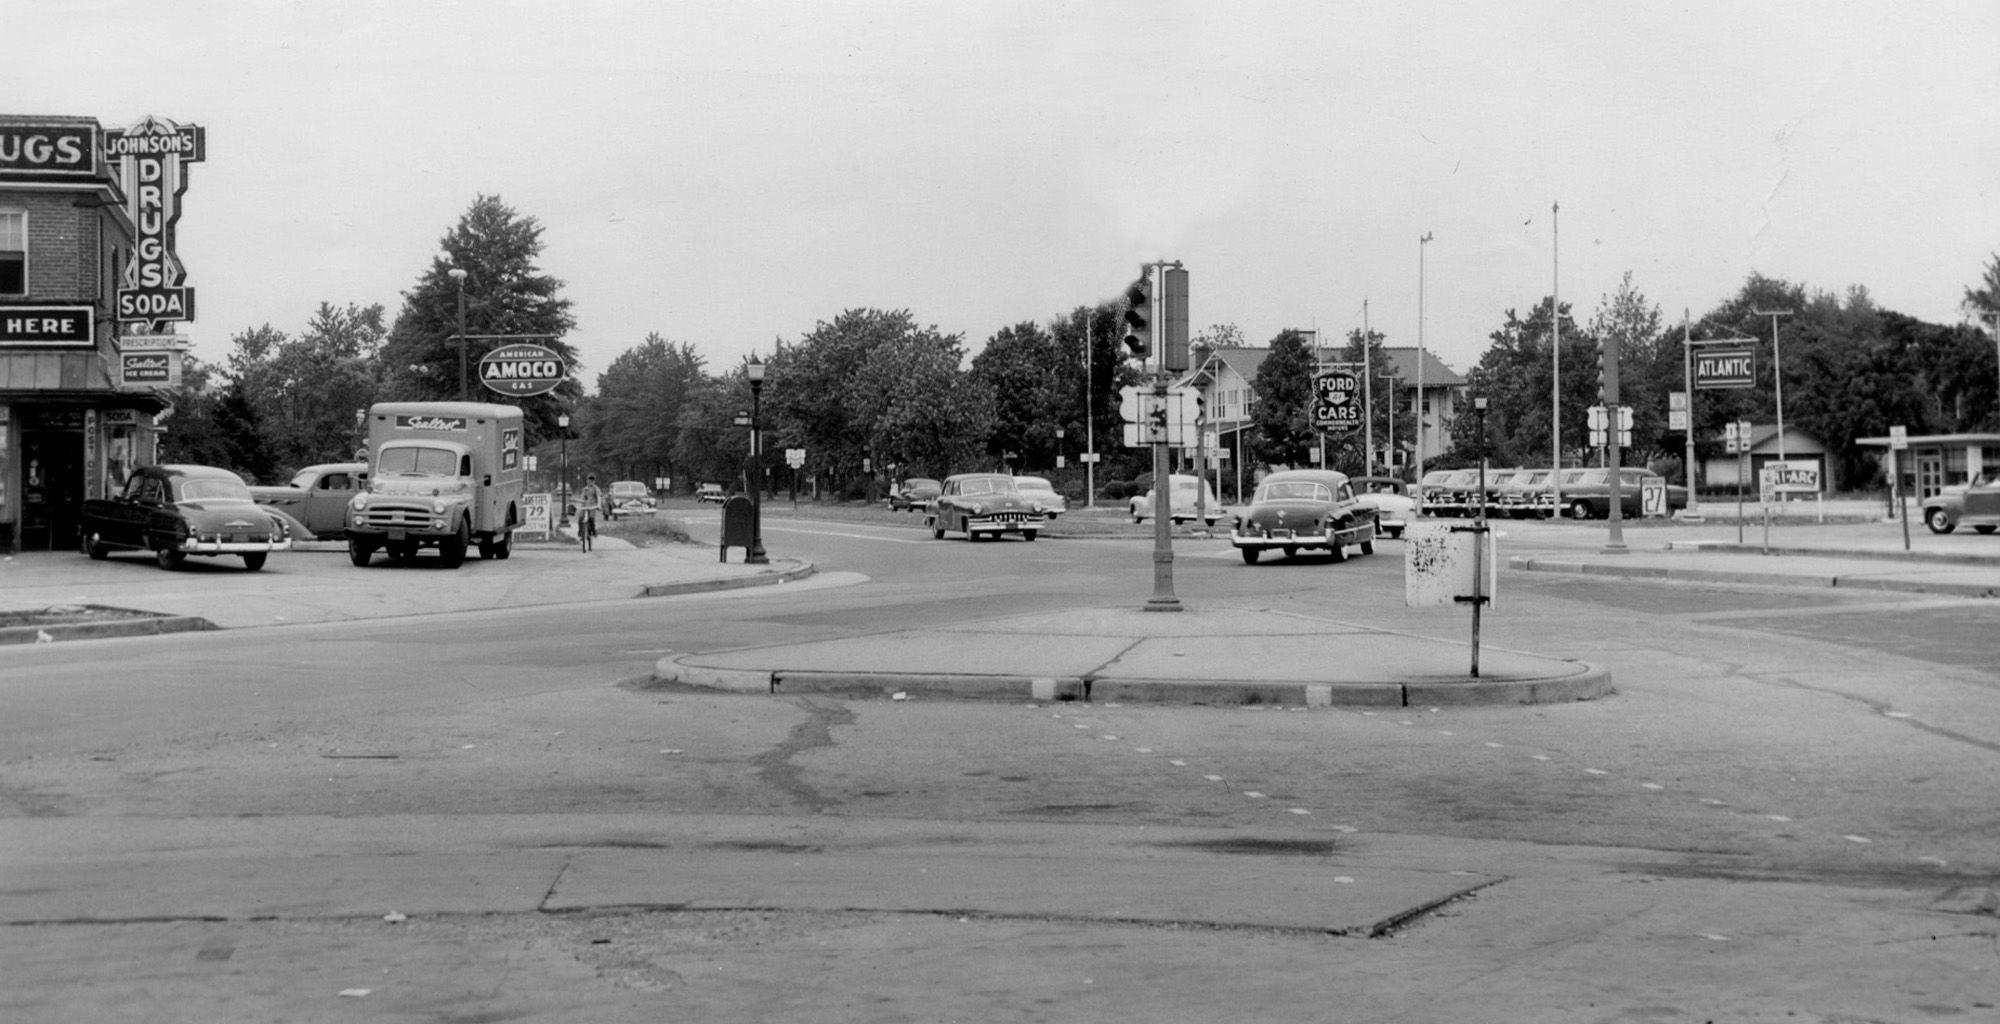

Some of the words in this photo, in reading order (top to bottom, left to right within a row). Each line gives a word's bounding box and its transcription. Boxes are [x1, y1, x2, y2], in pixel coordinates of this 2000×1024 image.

[106, 132, 193, 155] JOHNSON'S
[140, 159, 162, 287] DRUGS
[121, 294, 182, 315] SODA
[7, 318, 75, 333] HERE
[122, 338, 176, 347] PRESCRIPTIONS
[126, 357, 168, 369] Sealtest
[485, 361, 557, 379] AMOCO
[1698, 359, 1751, 376] ATLANTIC
[511, 382, 533, 390] GAS
[1319, 377, 1354, 391] FORD
[106, 412, 132, 422] SODA
[1318, 406, 1357, 420] CARS
[408, 416, 460, 431] Sealtest
[1645, 487, 1662, 512] 27
[528, 506, 544, 516] 79
